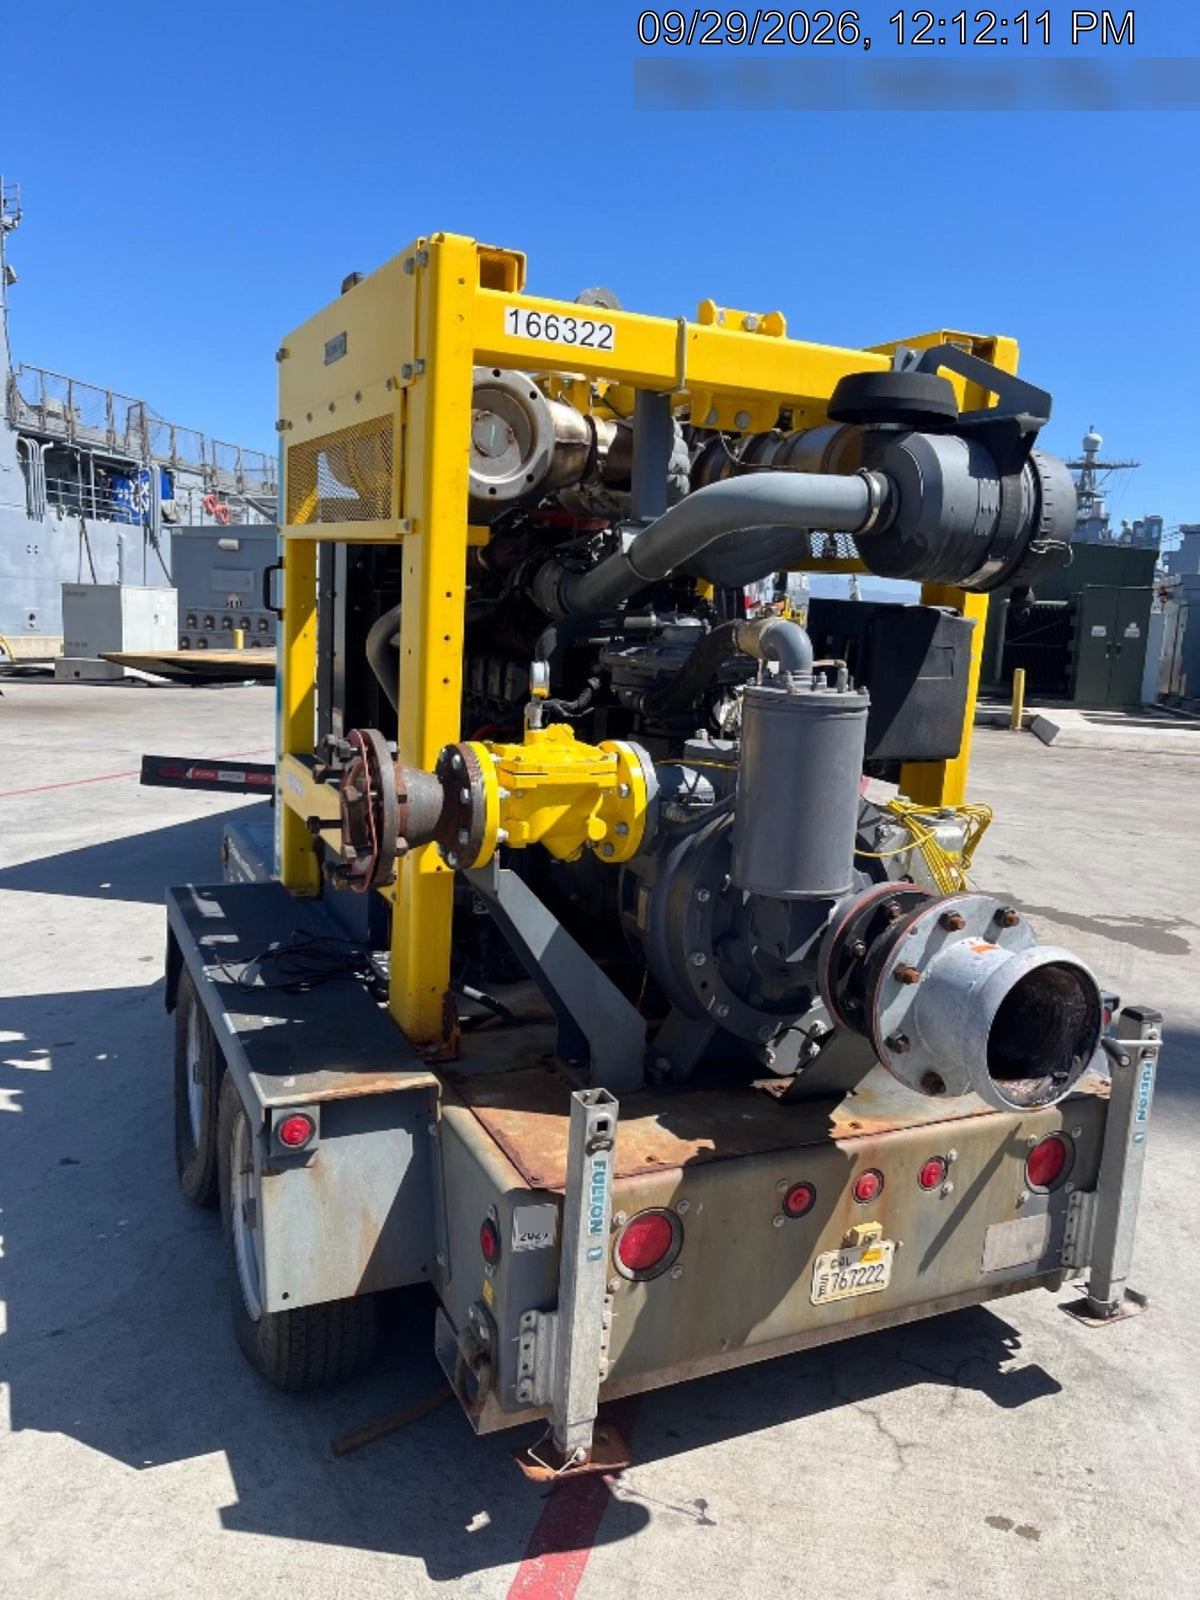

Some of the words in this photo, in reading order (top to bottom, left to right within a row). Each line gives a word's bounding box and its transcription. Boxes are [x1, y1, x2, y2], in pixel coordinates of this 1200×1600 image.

[509, 309, 613, 350] 166322
[1137, 1063, 1152, 1121] FULTON
[589, 1161, 607, 1235] FULTON
[831, 1263, 885, 1292] 767222
